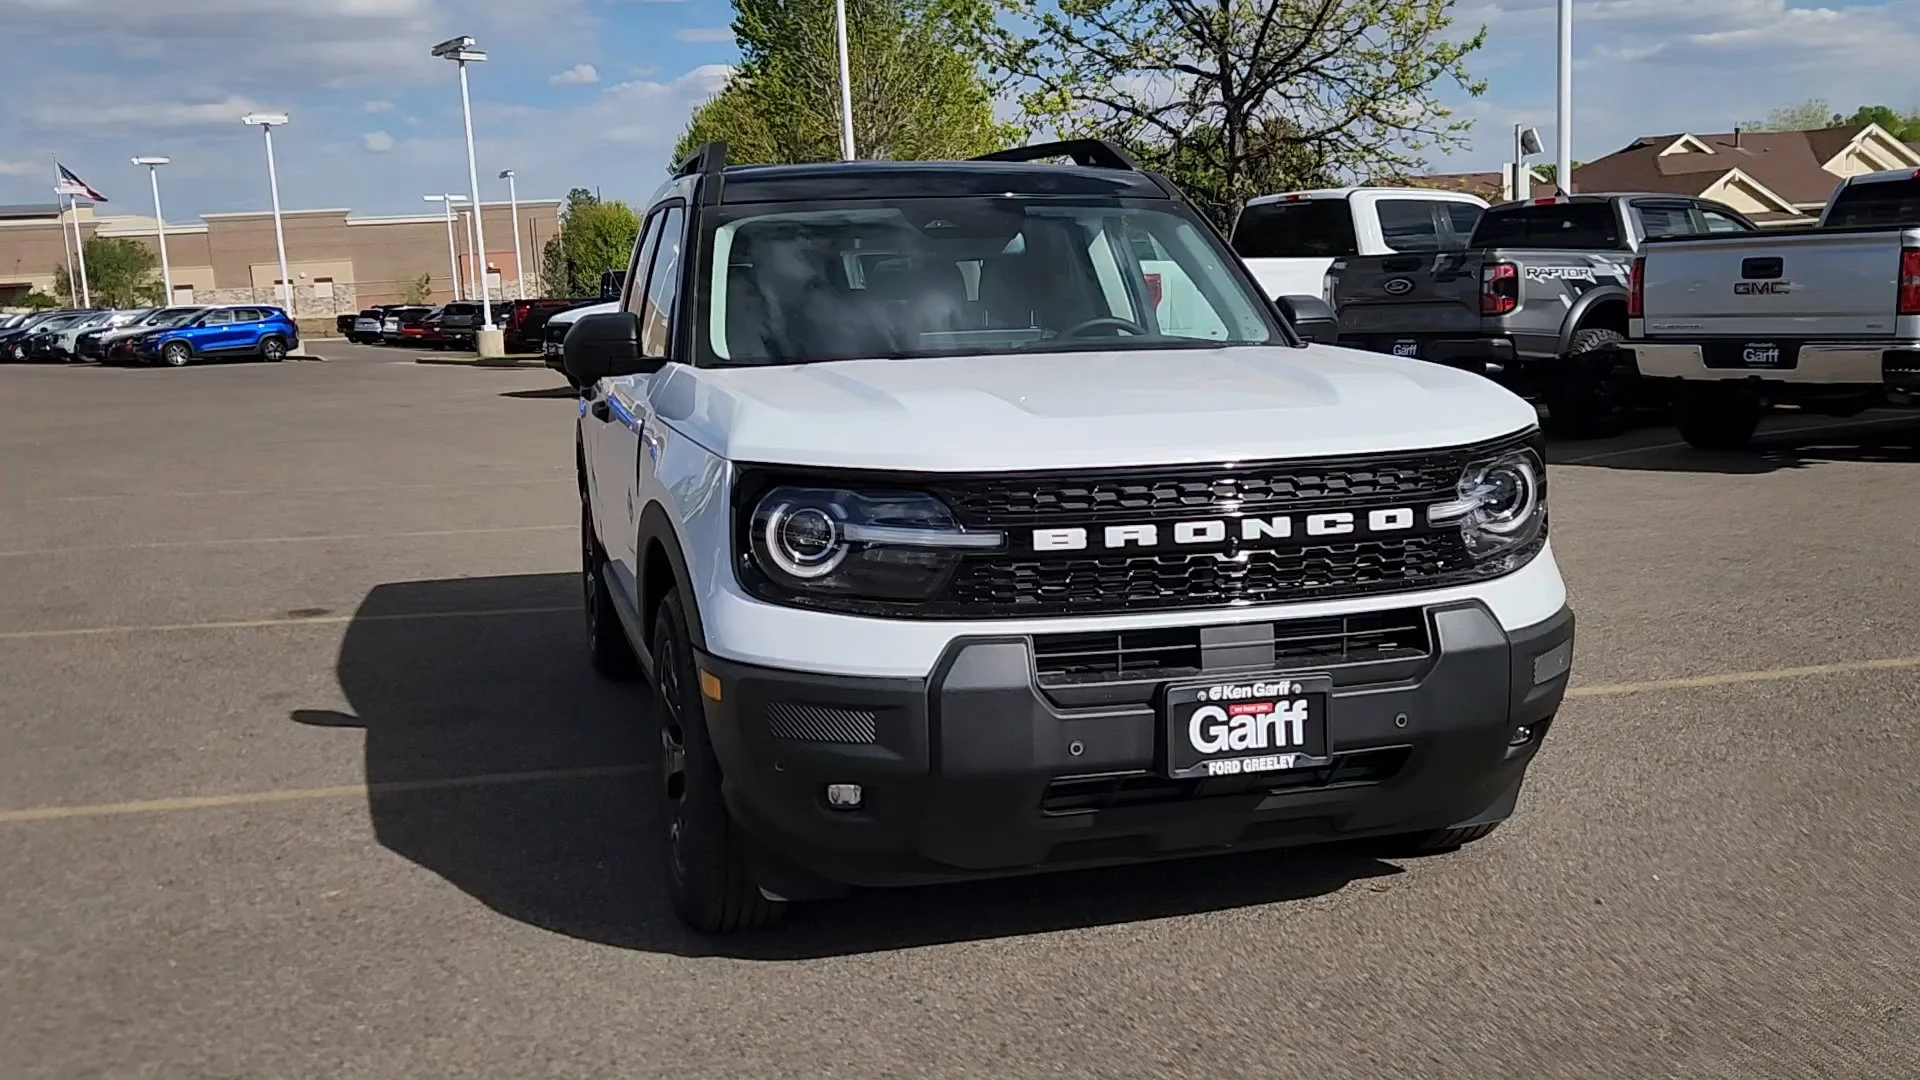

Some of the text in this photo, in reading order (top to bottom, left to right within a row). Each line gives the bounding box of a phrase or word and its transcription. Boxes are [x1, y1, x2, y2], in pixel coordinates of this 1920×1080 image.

[1525, 266, 1597, 284] RAPTOR
[1734, 281, 1790, 295] GMC
[1393, 344, 1417, 356] Garff
[1743, 348, 1779, 362] Garff
[1032, 507, 1414, 551] BRONCO
[1222, 685, 1252, 700] Ken
[1252, 681, 1291, 698] Garff
[1188, 699, 1308, 754] Garff
[1208, 755, 1296, 776] FORD GREELEY
